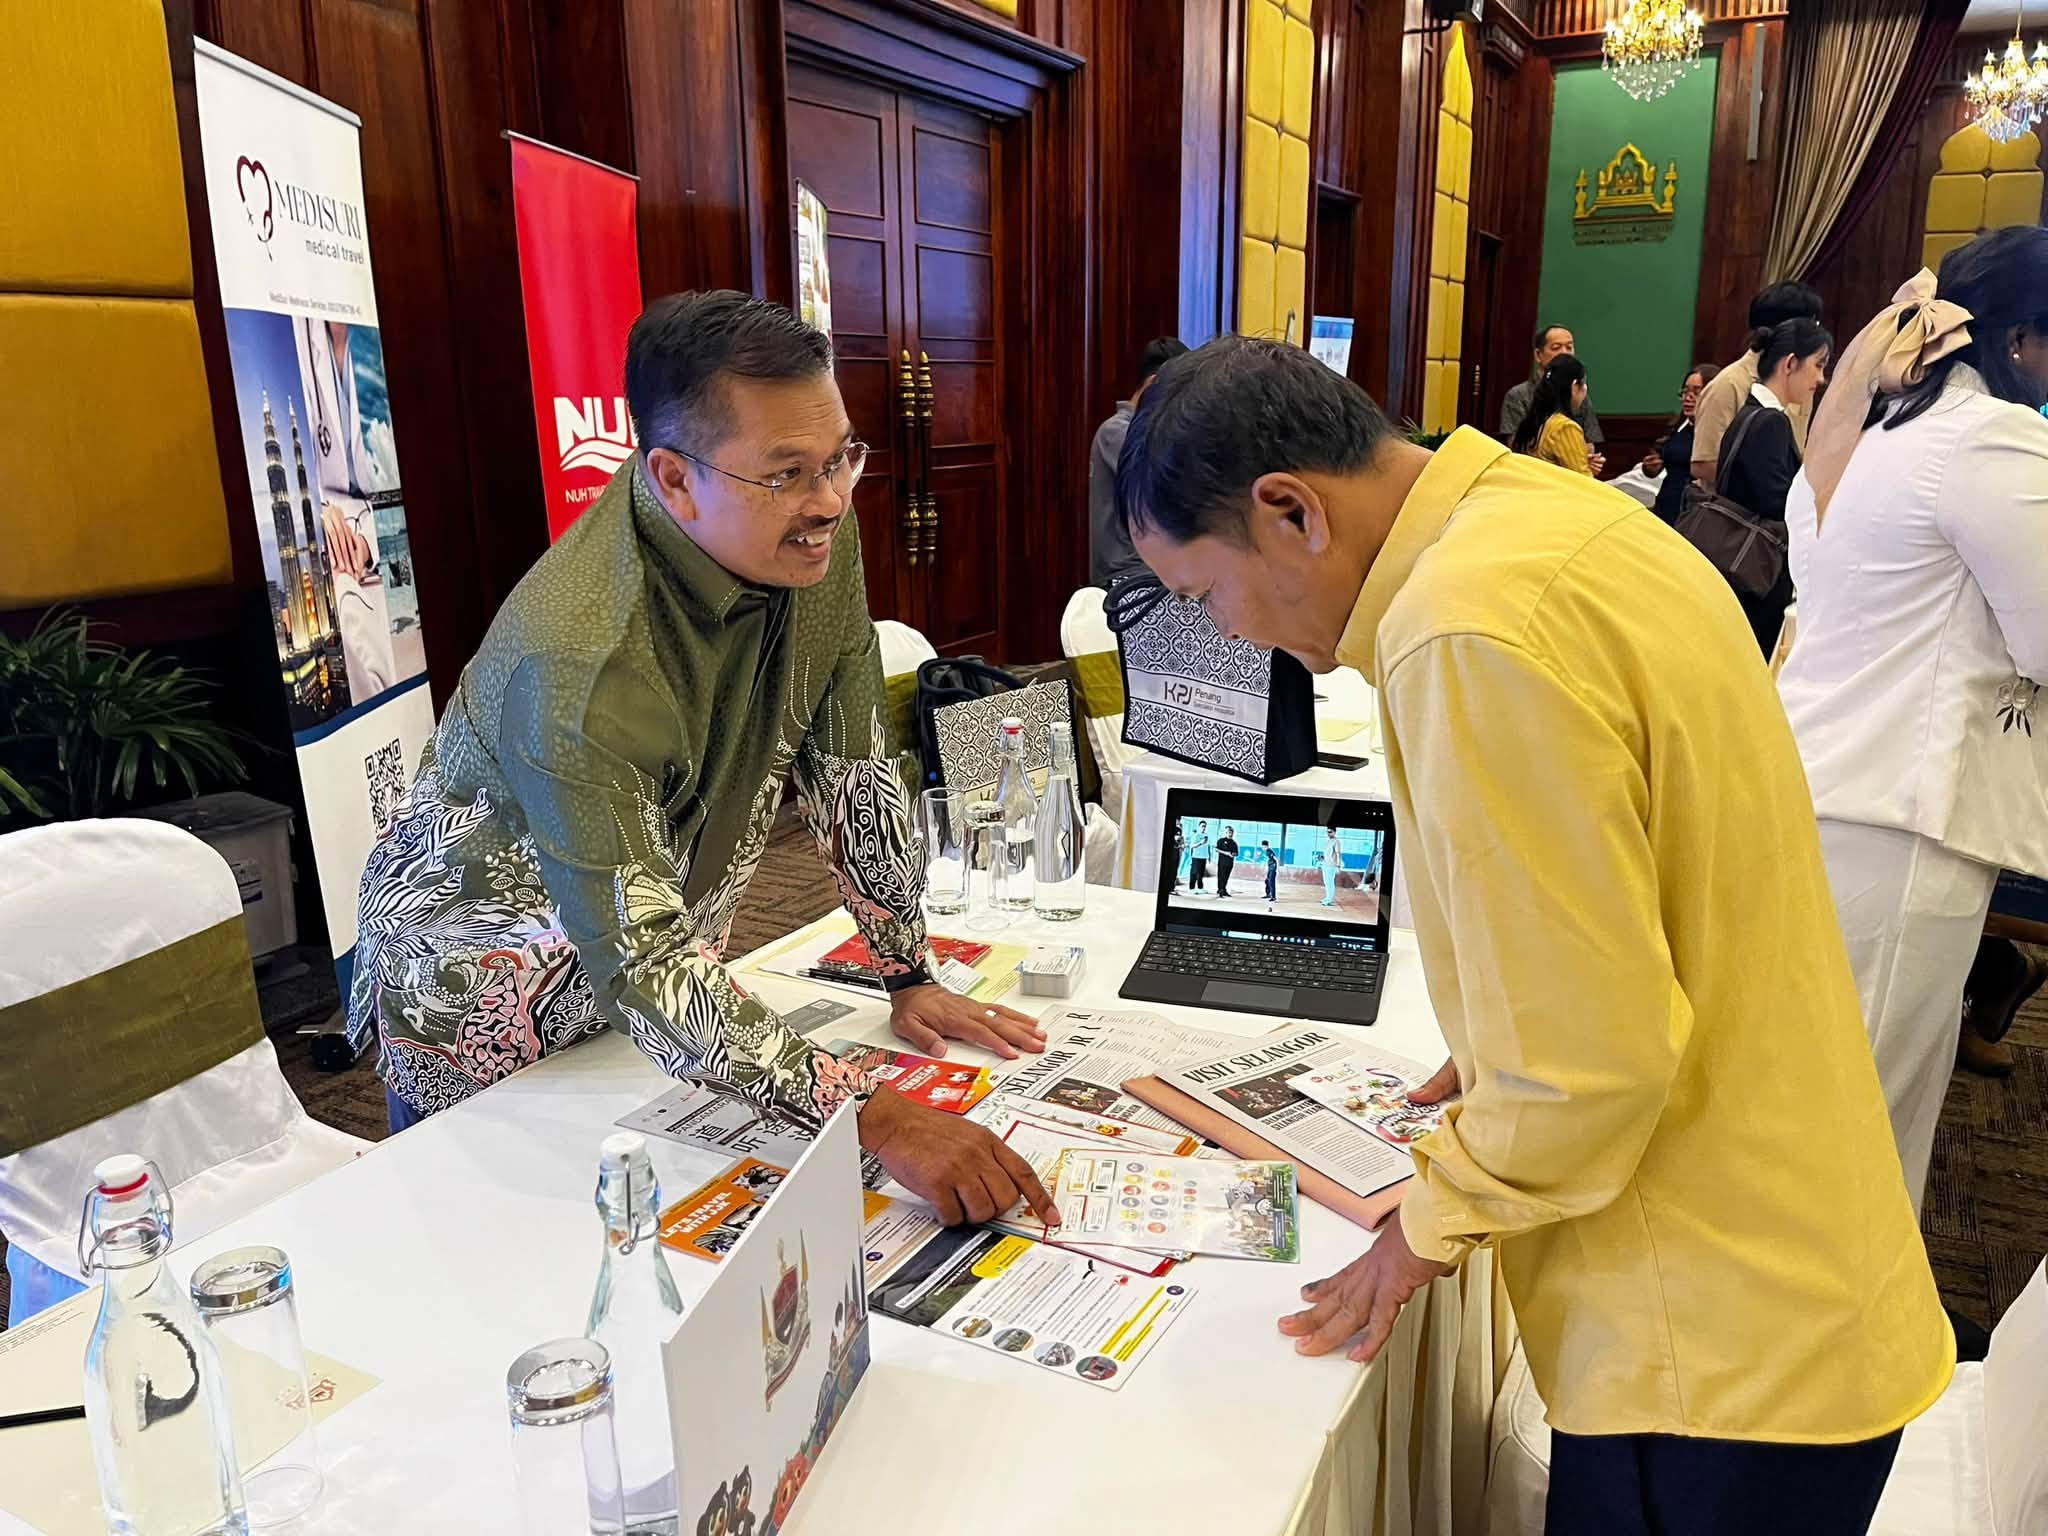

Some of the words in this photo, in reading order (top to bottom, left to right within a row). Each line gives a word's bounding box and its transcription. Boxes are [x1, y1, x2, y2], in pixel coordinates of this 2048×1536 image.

[275, 180, 361, 240] MEDISURI
[306, 239, 339, 260] medical
[342, 245, 364, 264] travel
[554, 397, 639, 458] NU
[565, 488, 587, 503] NUH
[1164, 680, 1193, 706] KPJ
[1195, 687, 1221, 704] Penang
[1002, 1050, 1077, 1095] SELANGOR
[1182, 1062, 1236, 1084] VISIT
[1230, 1032, 1331, 1071] SELANGOR
[674, 1099, 733, 1136] PANDAMARA
